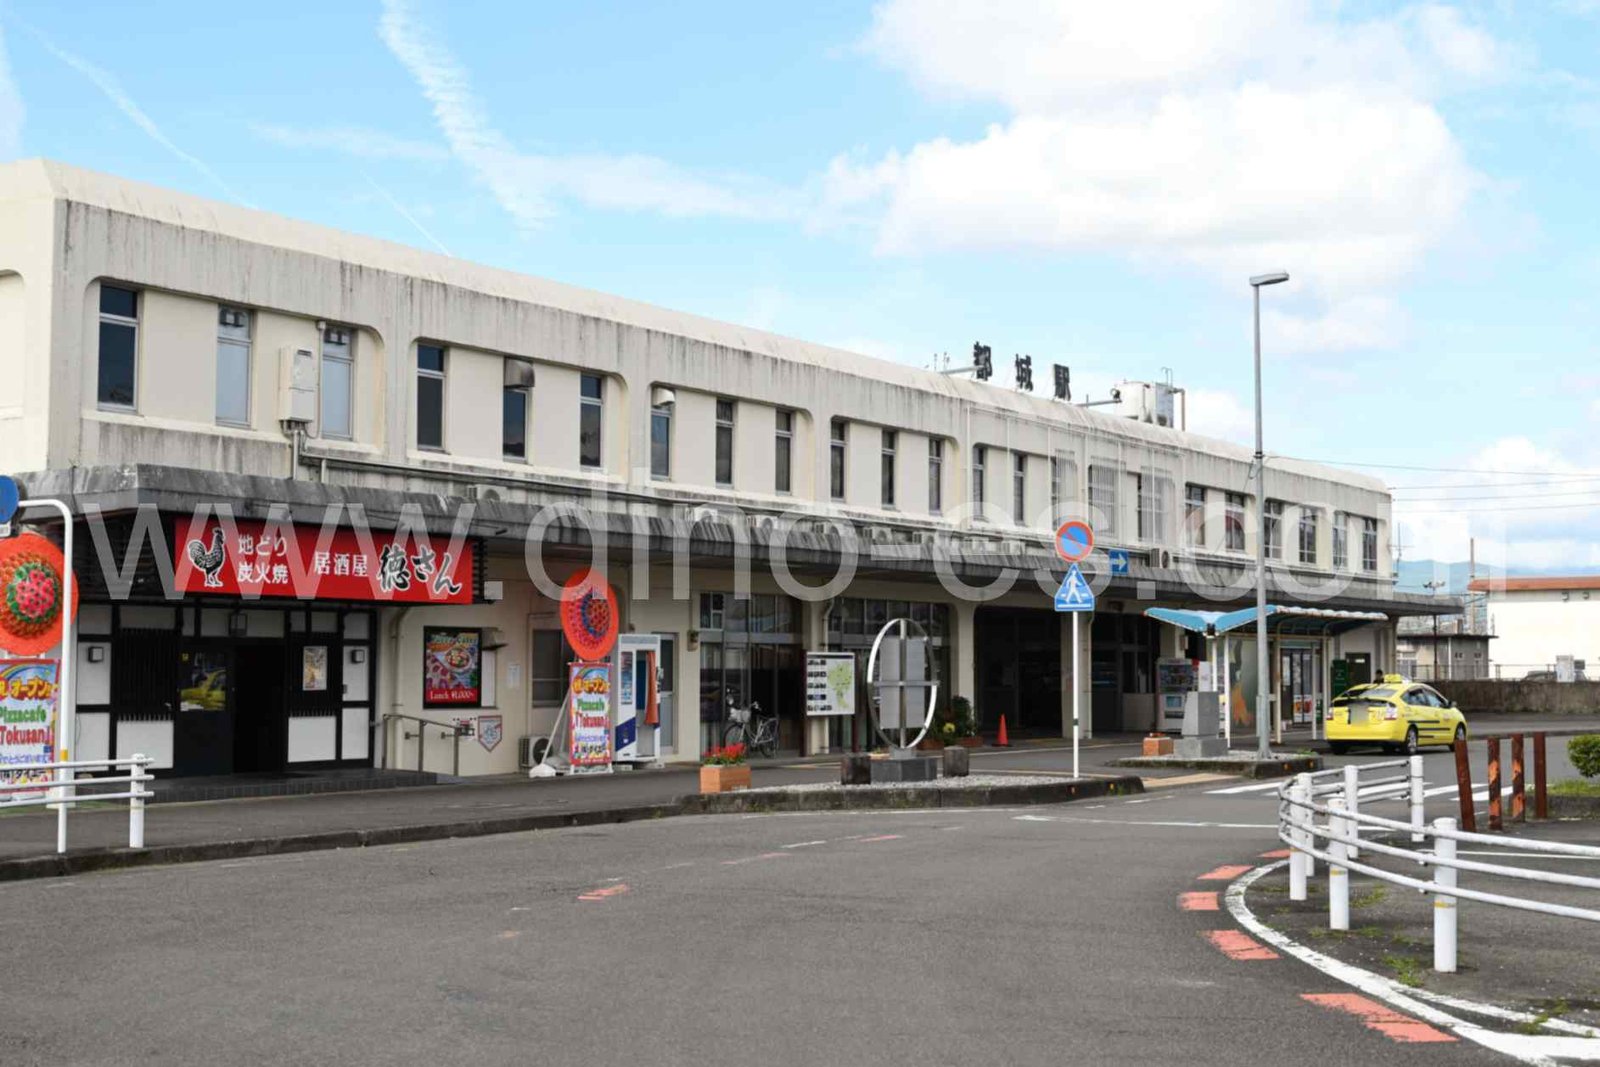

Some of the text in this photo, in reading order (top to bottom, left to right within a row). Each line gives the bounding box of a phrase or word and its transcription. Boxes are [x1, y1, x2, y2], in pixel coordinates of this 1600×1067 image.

[973, 341, 1071, 401] 都城駅
[238, 534, 288, 556] 地どり
[237, 562, 289, 584] 炭火焼
[314, 543, 462, 595] 居酒屋 徳さん
